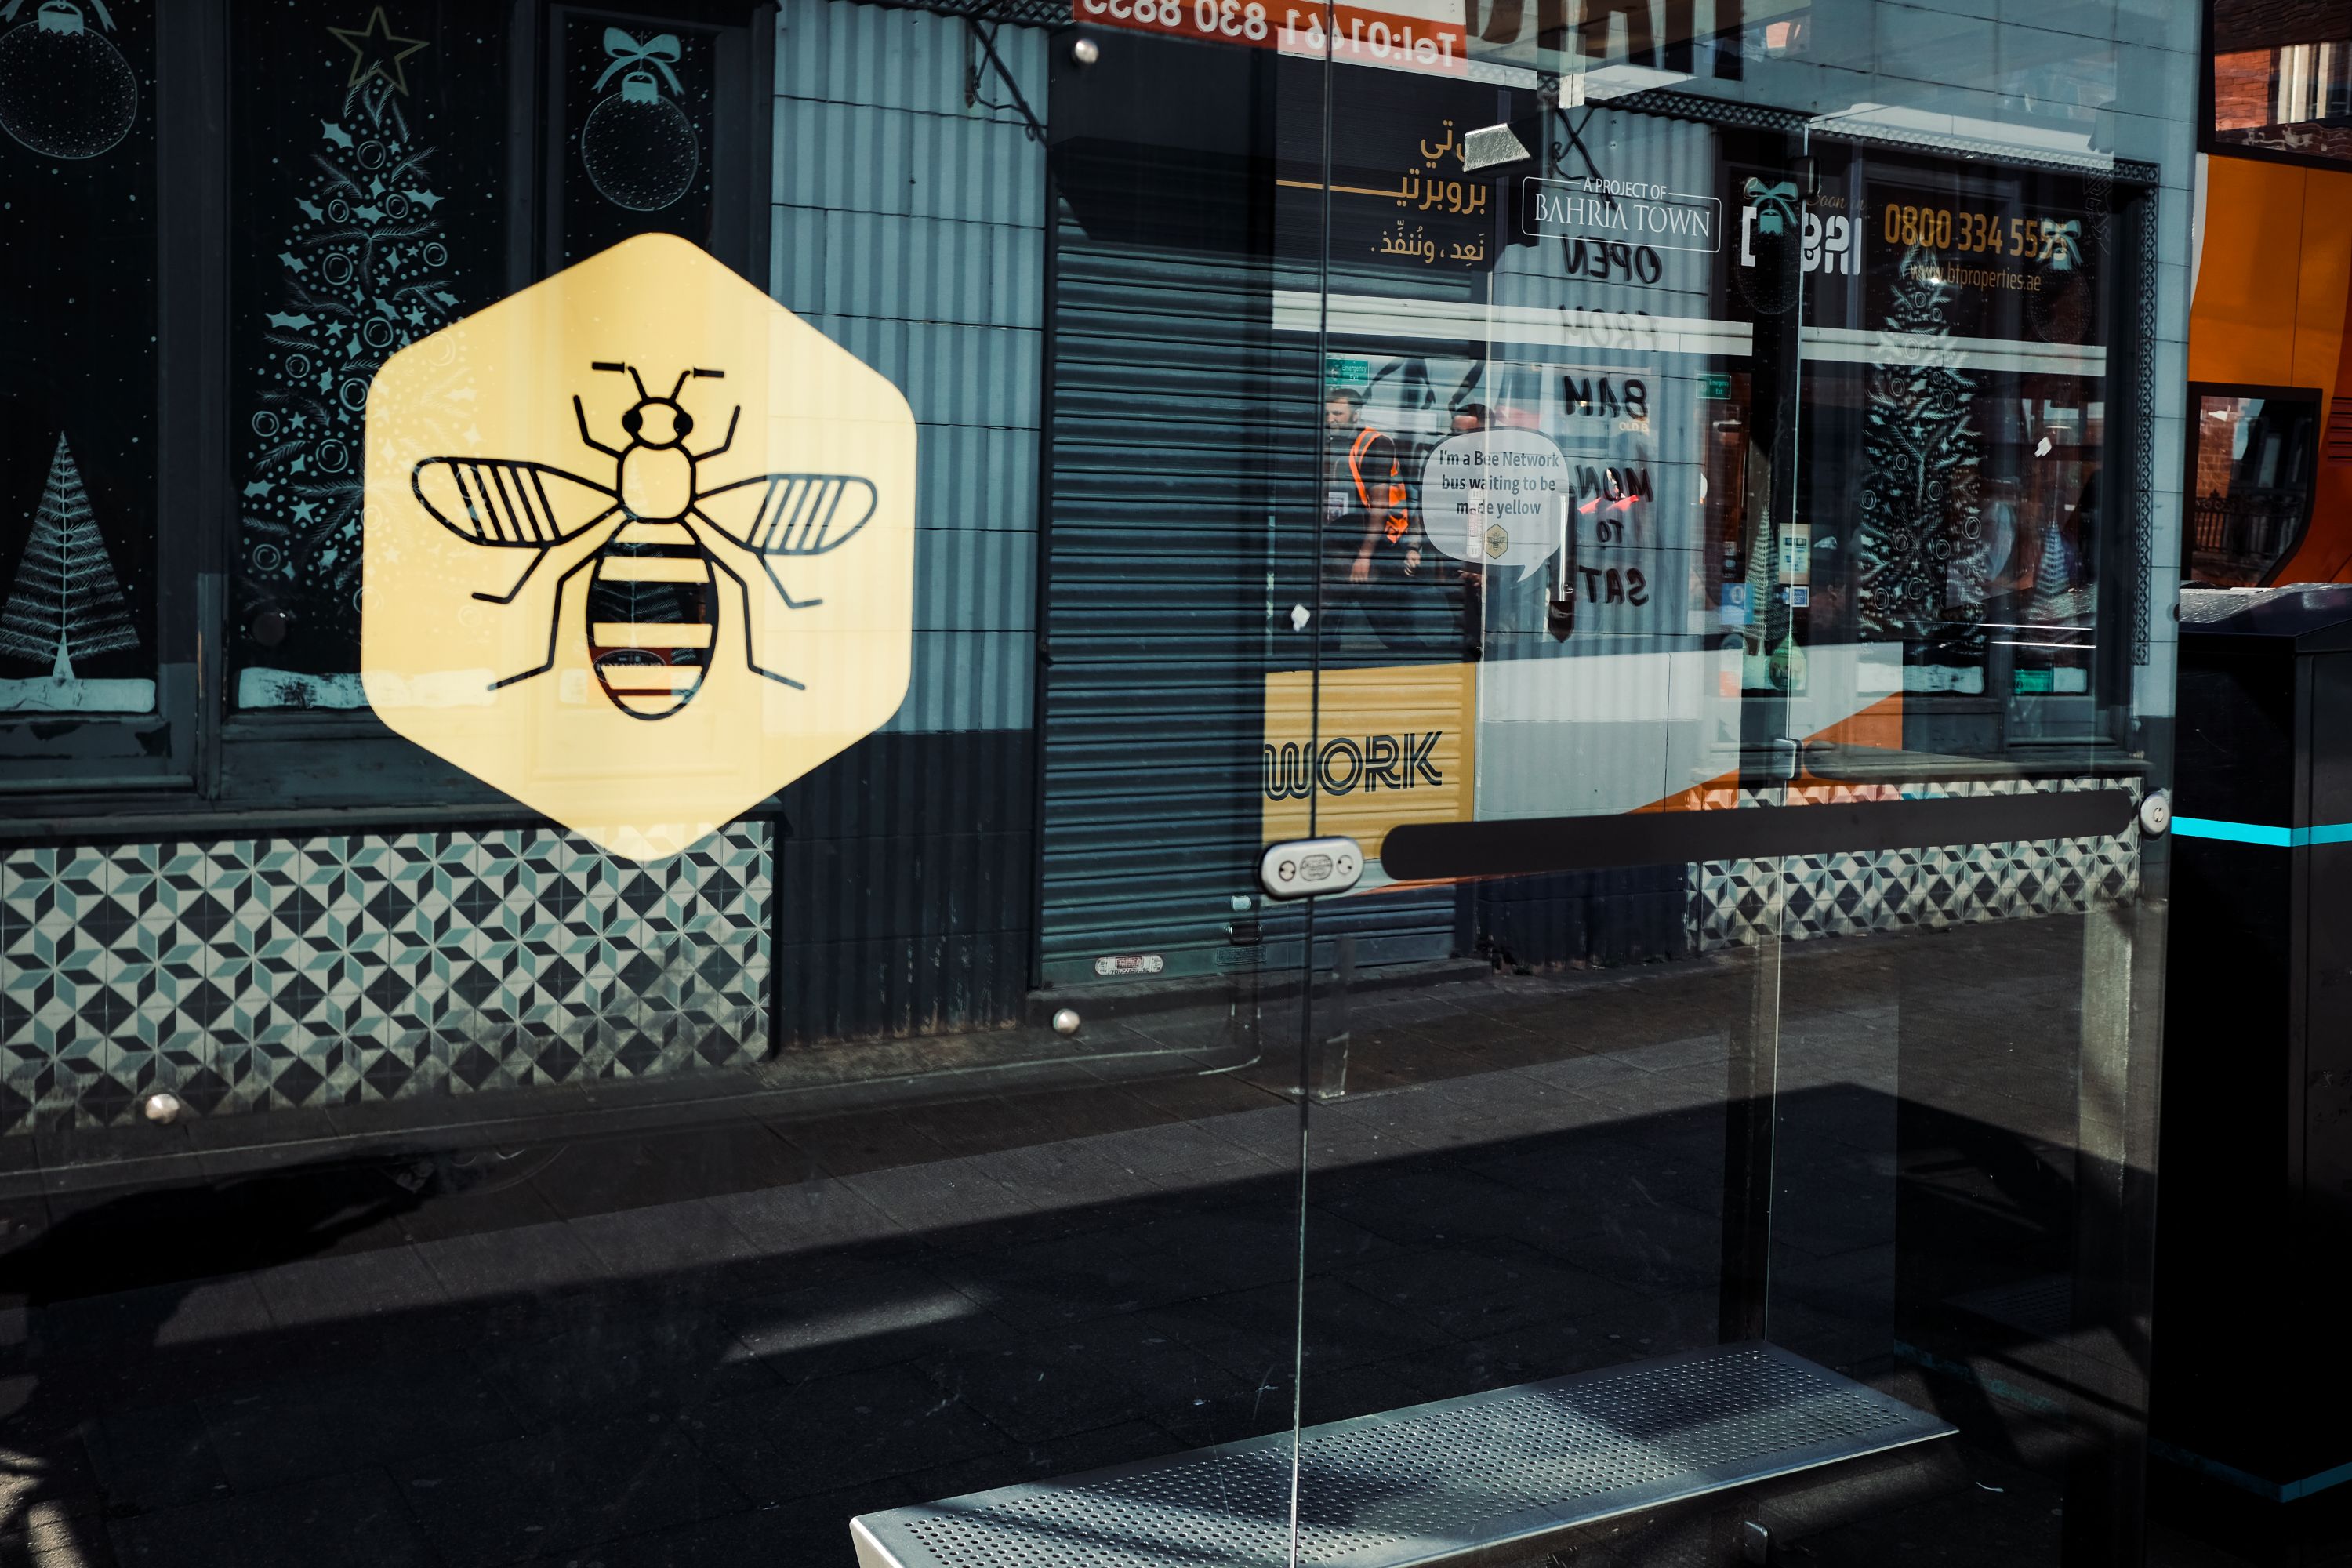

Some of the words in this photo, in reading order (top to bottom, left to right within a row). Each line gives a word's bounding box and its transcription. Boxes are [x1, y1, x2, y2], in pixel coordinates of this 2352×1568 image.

[1584, 177, 1592, 192] A
[1595, 179, 1648, 198] PROJECT
[1650, 184, 1667, 200] OF
[1534, 194, 1628, 230] BAHRIA
[1633, 204, 1711, 238] TOWN
[1885, 203, 1951, 249] 0800
[1958, 212, 2002, 254] 334
[1341, 364, 1367, 373] Emergency
[1439, 450, 1459, 465] I'm
[1463, 453, 1470, 465] a
[1475, 450, 1499, 466] Bee
[1503, 451, 1559, 467] Network
[1442, 474, 1466, 490] bus
[1470, 475, 1519, 495] waiting
[1523, 477, 1537, 490] to
[1540, 476, 1555, 491] be
[1457, 499, 1494, 514] made
[1497, 499, 1541, 518] yellow
[1264, 731, 1443, 801] WORK
